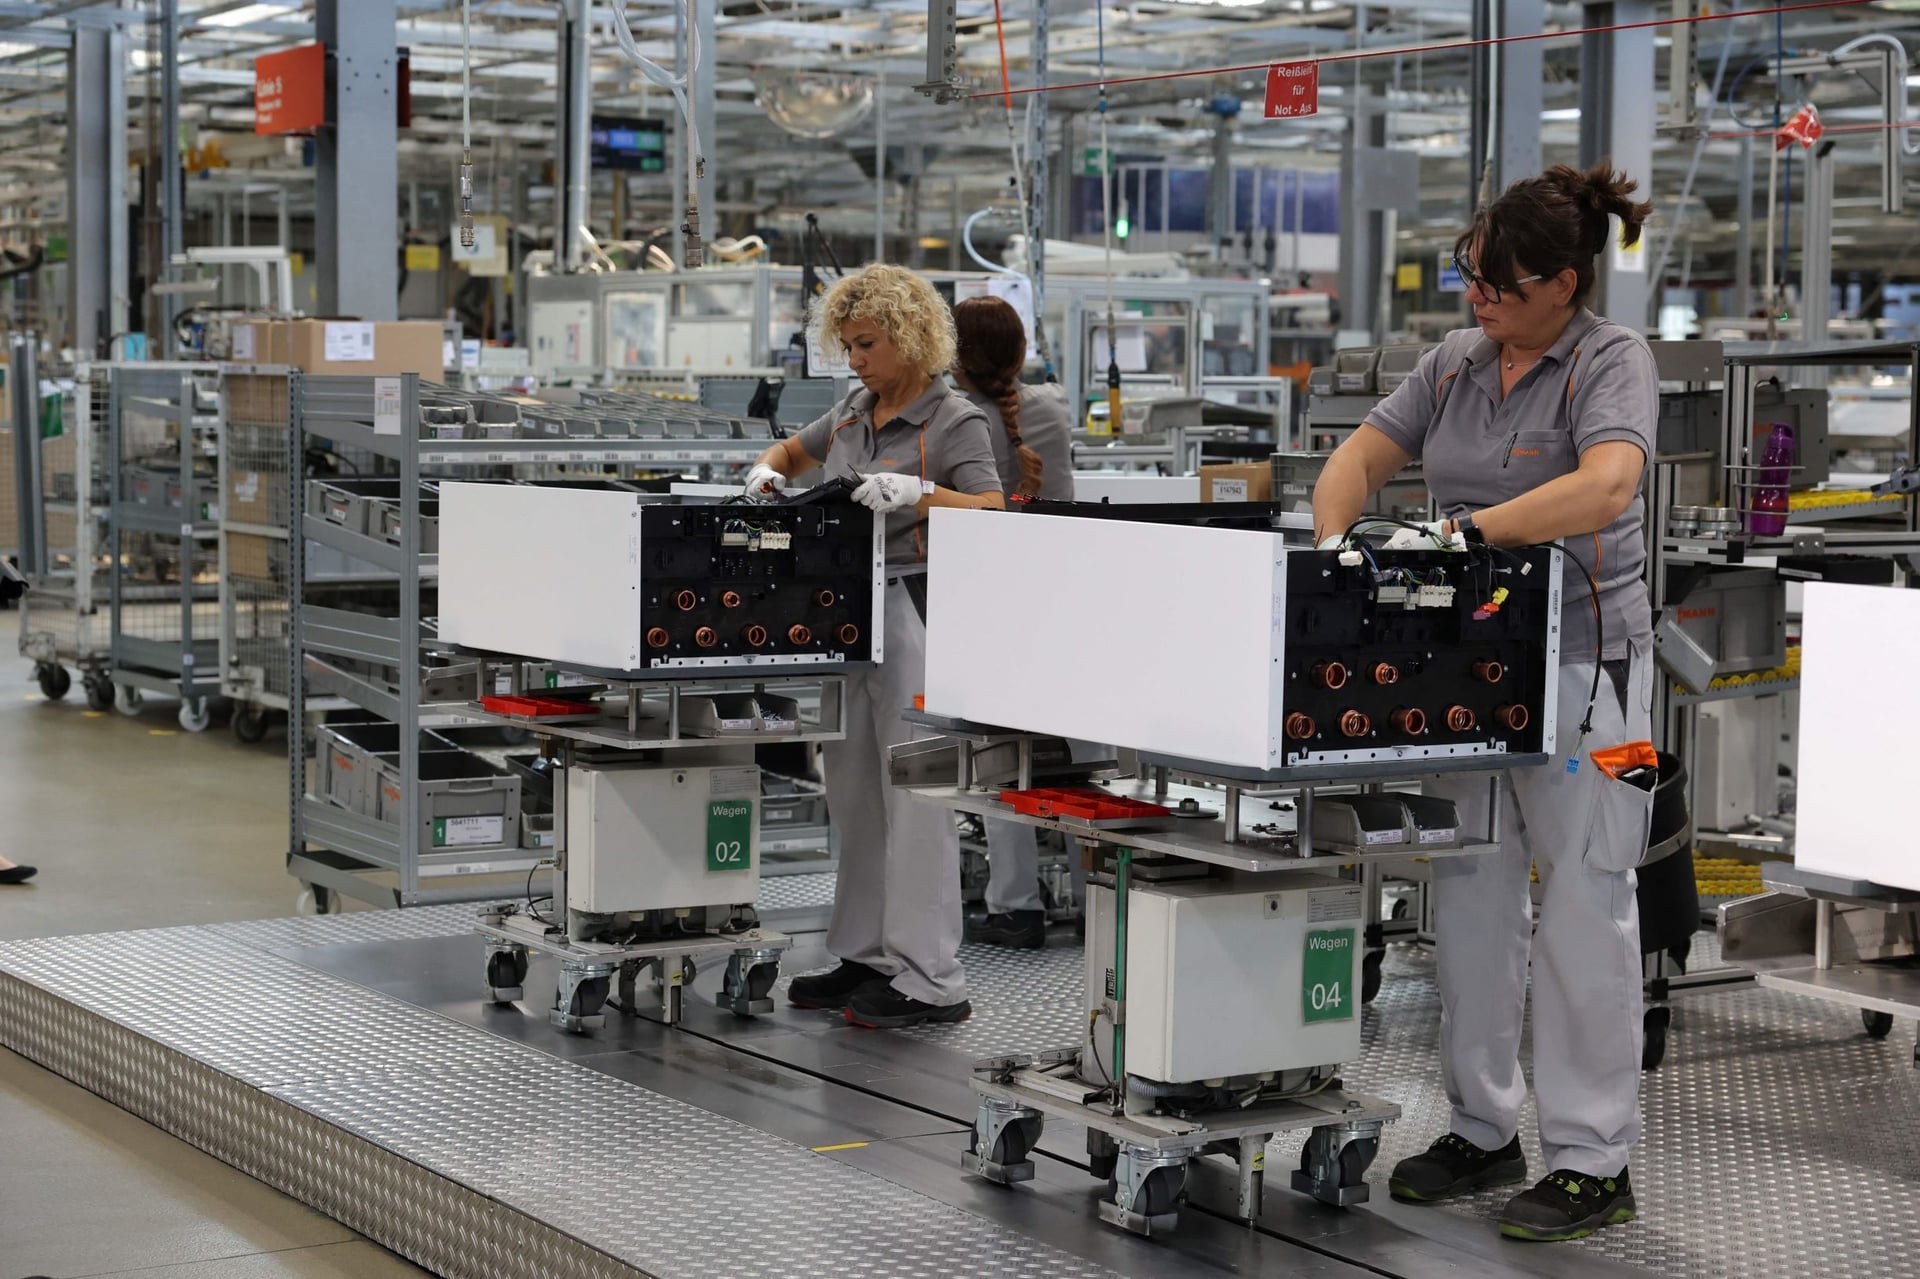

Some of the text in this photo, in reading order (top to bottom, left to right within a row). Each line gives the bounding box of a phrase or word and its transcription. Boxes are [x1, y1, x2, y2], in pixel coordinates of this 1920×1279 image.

[1292, 84, 1305, 96] für
[1274, 104, 1292, 116] Not
[712, 805, 747, 817] Wagen
[715, 841, 741, 863] 02
[1309, 937, 1348, 951] Wagen
[1311, 981, 1341, 1010] 04
